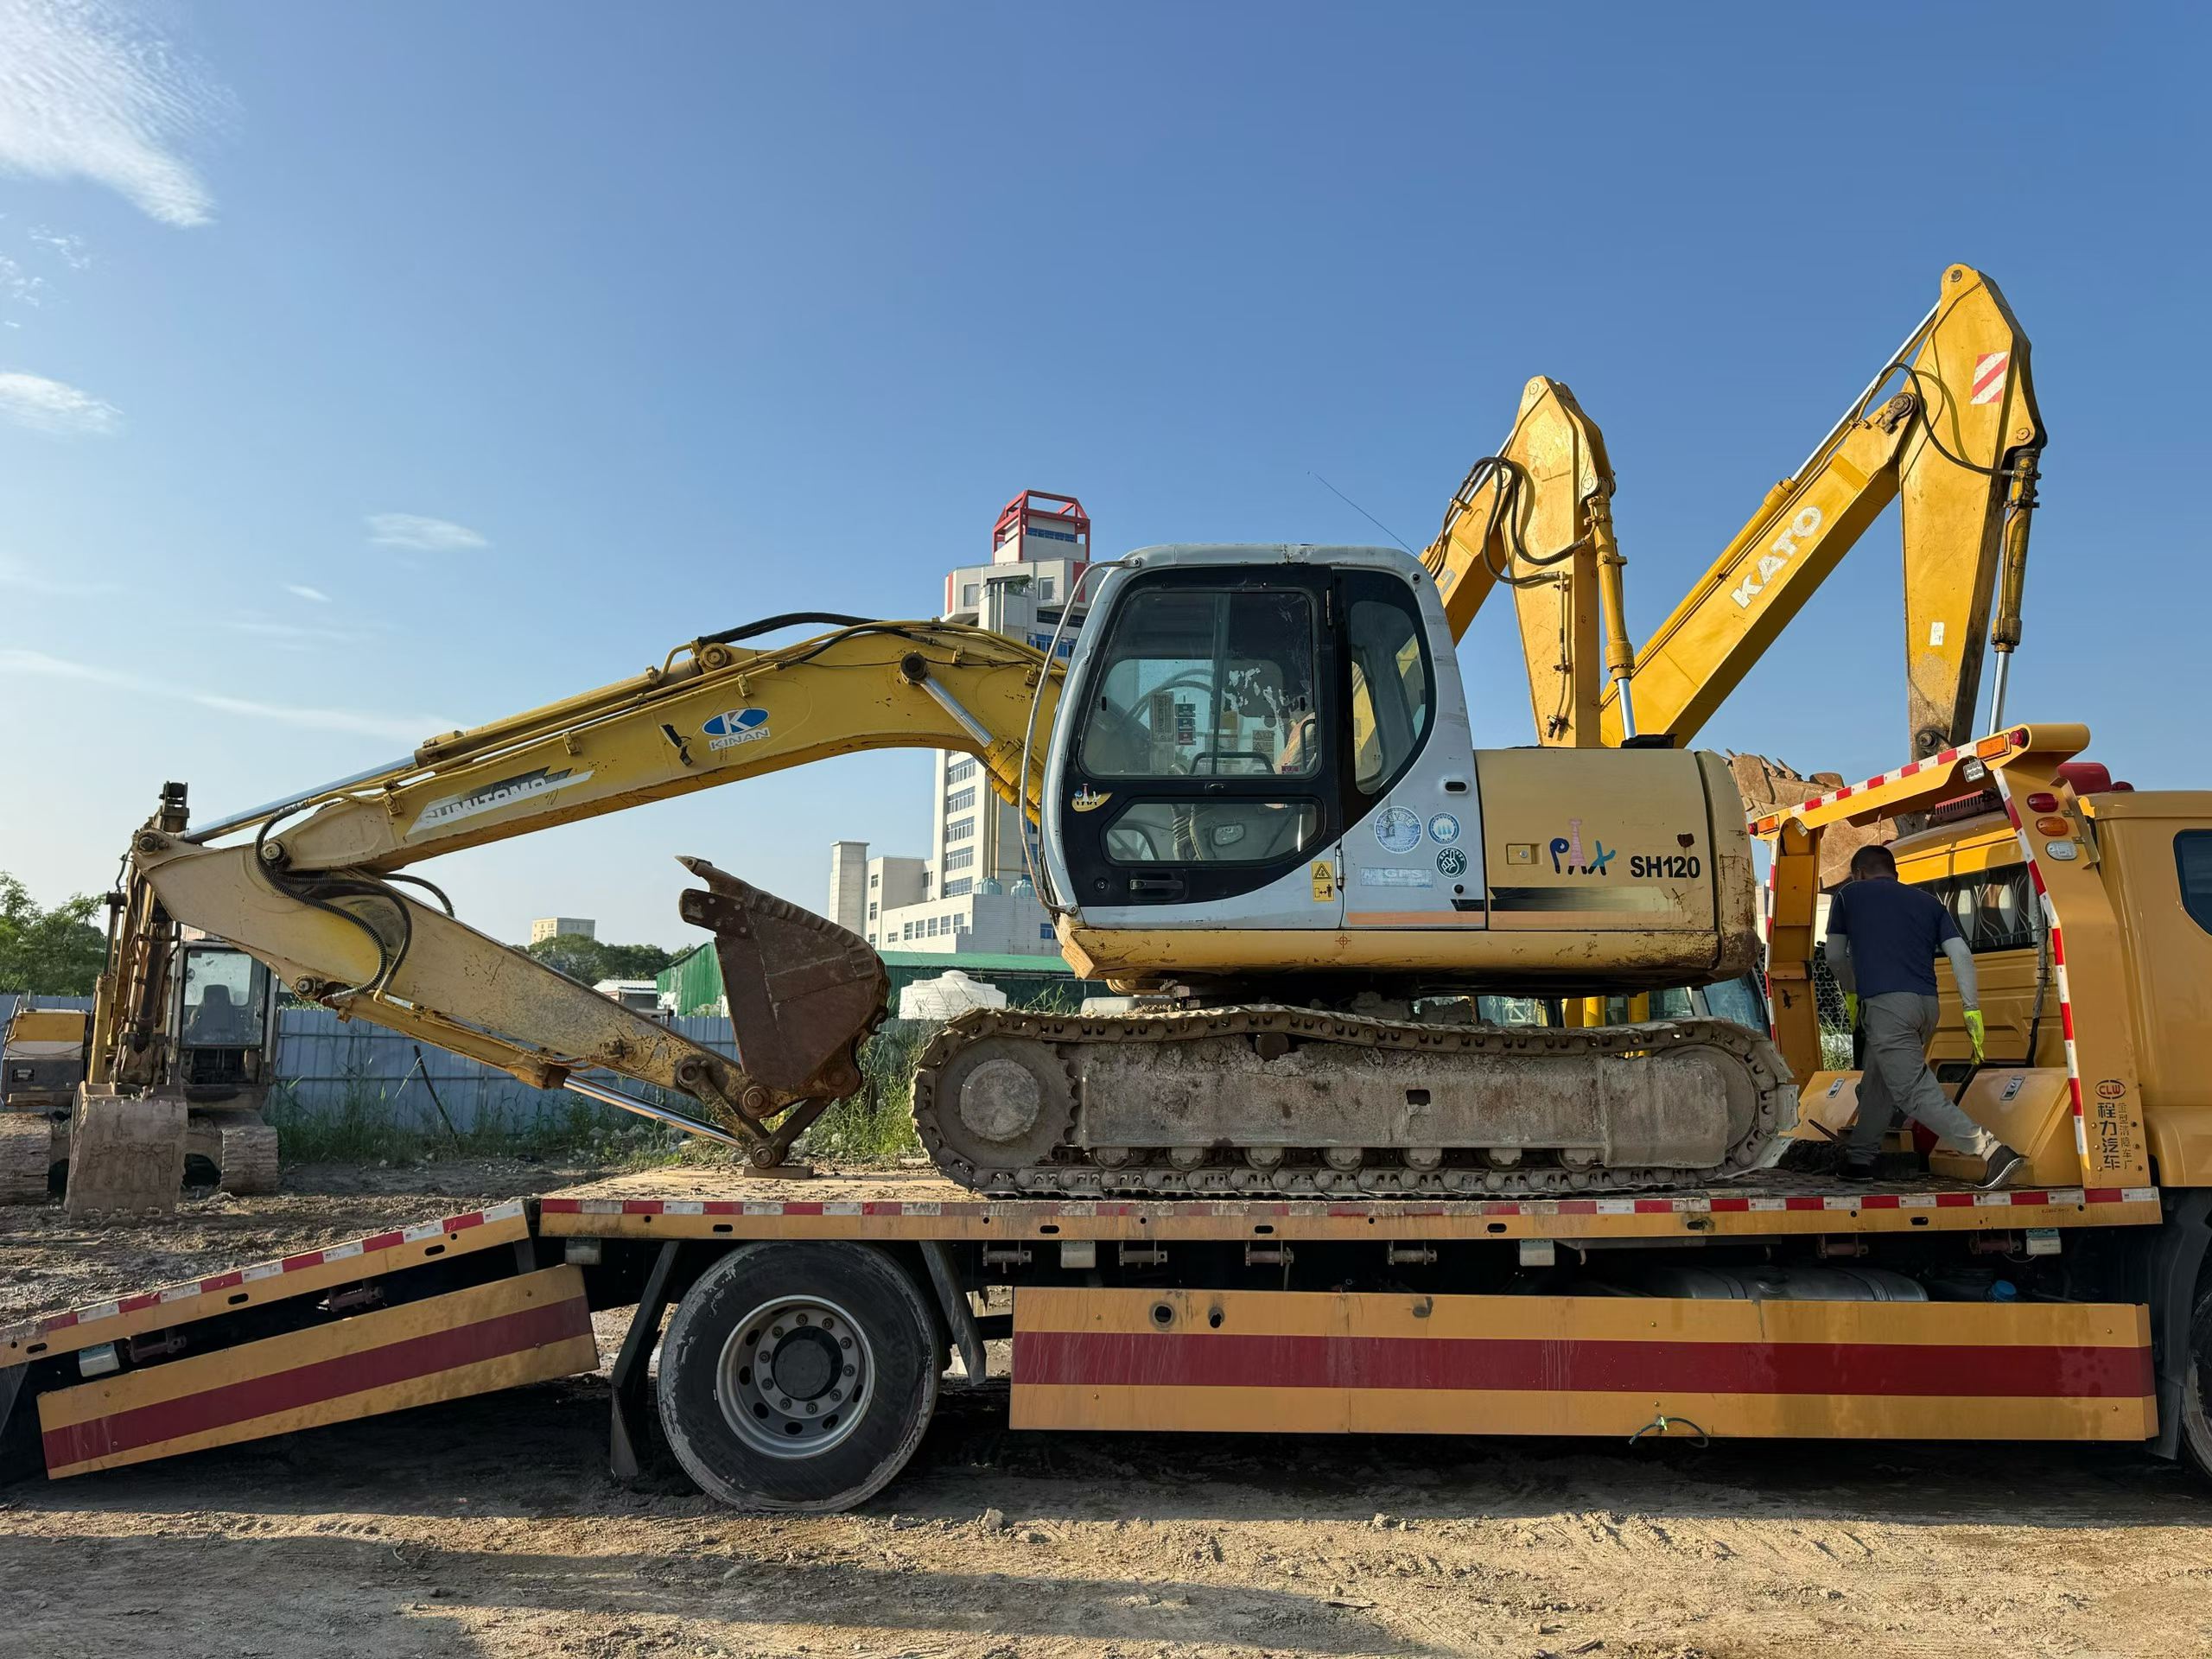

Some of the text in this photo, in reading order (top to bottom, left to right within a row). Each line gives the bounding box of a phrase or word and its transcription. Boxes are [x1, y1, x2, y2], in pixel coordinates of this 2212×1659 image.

[1730, 506, 1821, 608] KATO
[710, 728, 769, 750] KINAN
[1630, 855, 1700, 878] SH120
[2098, 1084, 2121, 1096] CLW
[2097, 1102, 2121, 1170] 程力汽车
